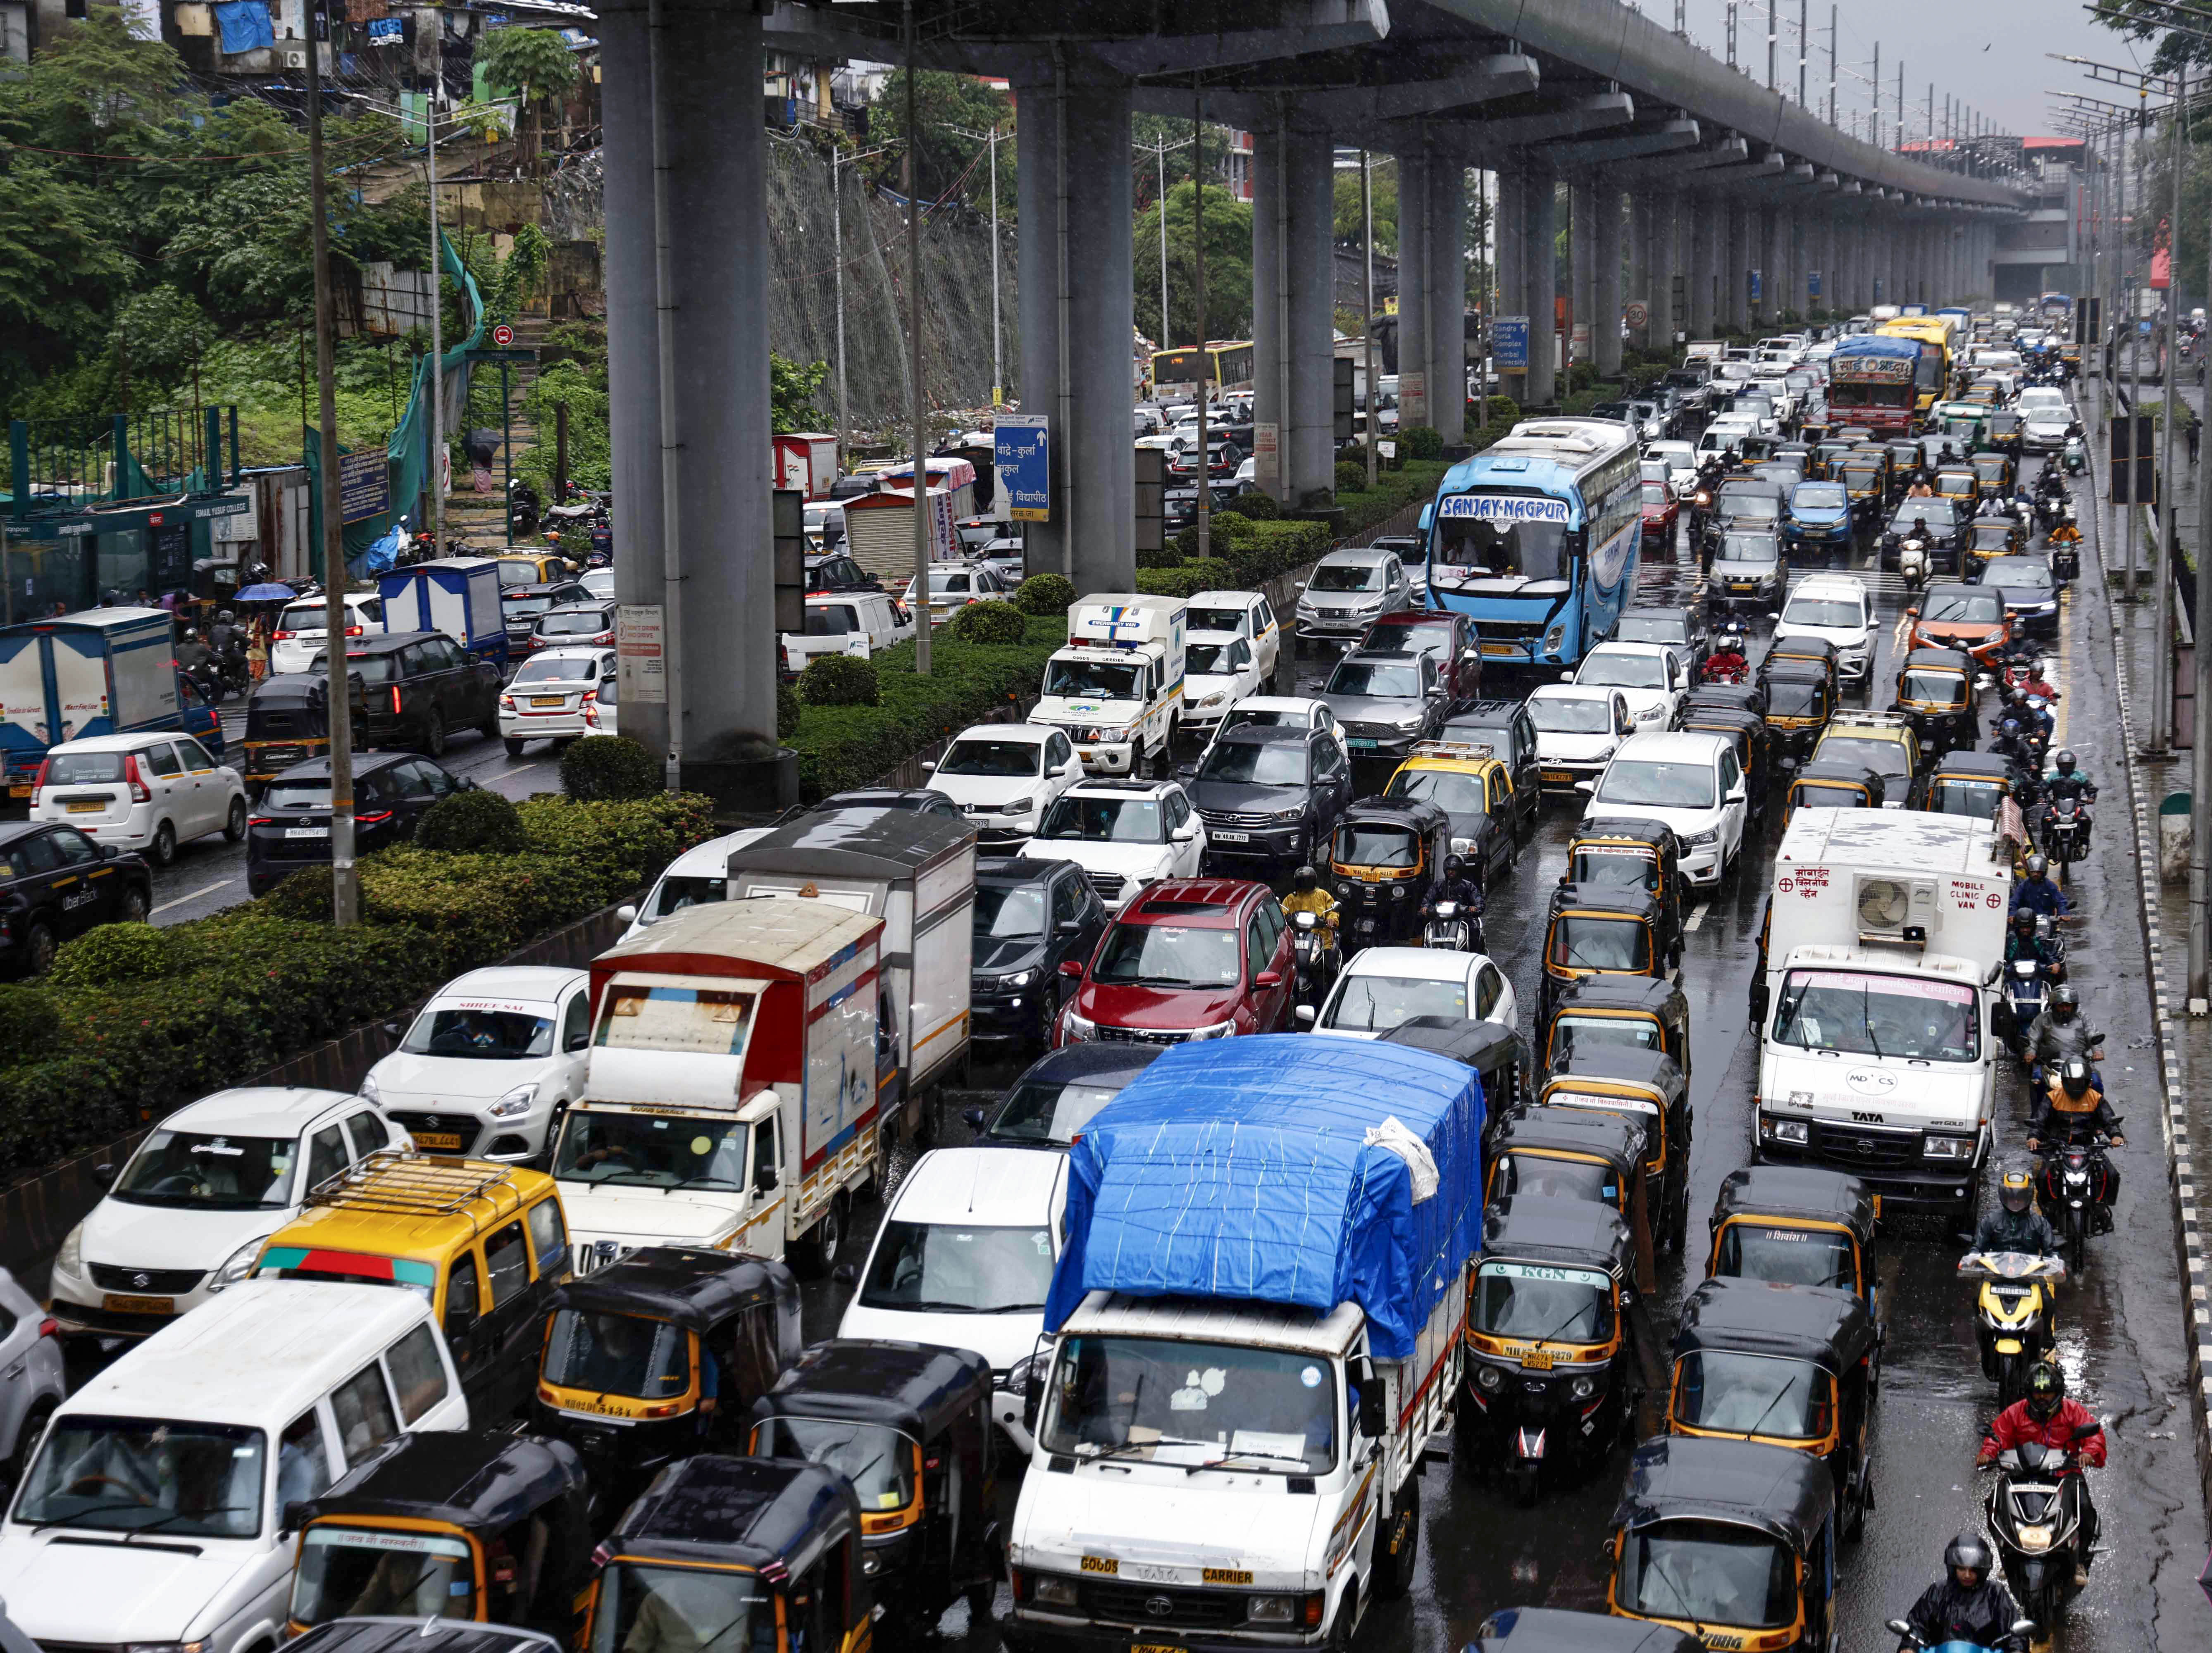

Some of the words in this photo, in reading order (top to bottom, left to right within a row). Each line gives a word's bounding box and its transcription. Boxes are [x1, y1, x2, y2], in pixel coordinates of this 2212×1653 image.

[1630, 310, 1643, 319] 30
[1016, 490, 1046, 503] विद्यापीठ
[195, 508, 211, 518] ISMAIL
[211, 505, 226, 515] YUSUF
[226, 502, 246, 512] COLLEGE
[1444, 498, 1567, 522] SANJAY-NAGPUR
[1794, 866, 1830, 878] मोबाईल
[1952, 881, 1985, 891] MOBILE
[63, 895, 79, 911] Uber
[79, 887, 97, 905] Black
[1950, 891, 1980, 900] CLINIC
[1957, 901, 1975, 910] VAN
[1852, 1111, 1884, 1123] TATA
[1521, 1266, 1568, 1280] KGN
[599, 1404, 632, 1417] 5434
[1081, 1558, 1118, 1574] GOODS
[1137, 1566, 1183, 1584] TATA
[1202, 1569, 1252, 1584] CARRIER
